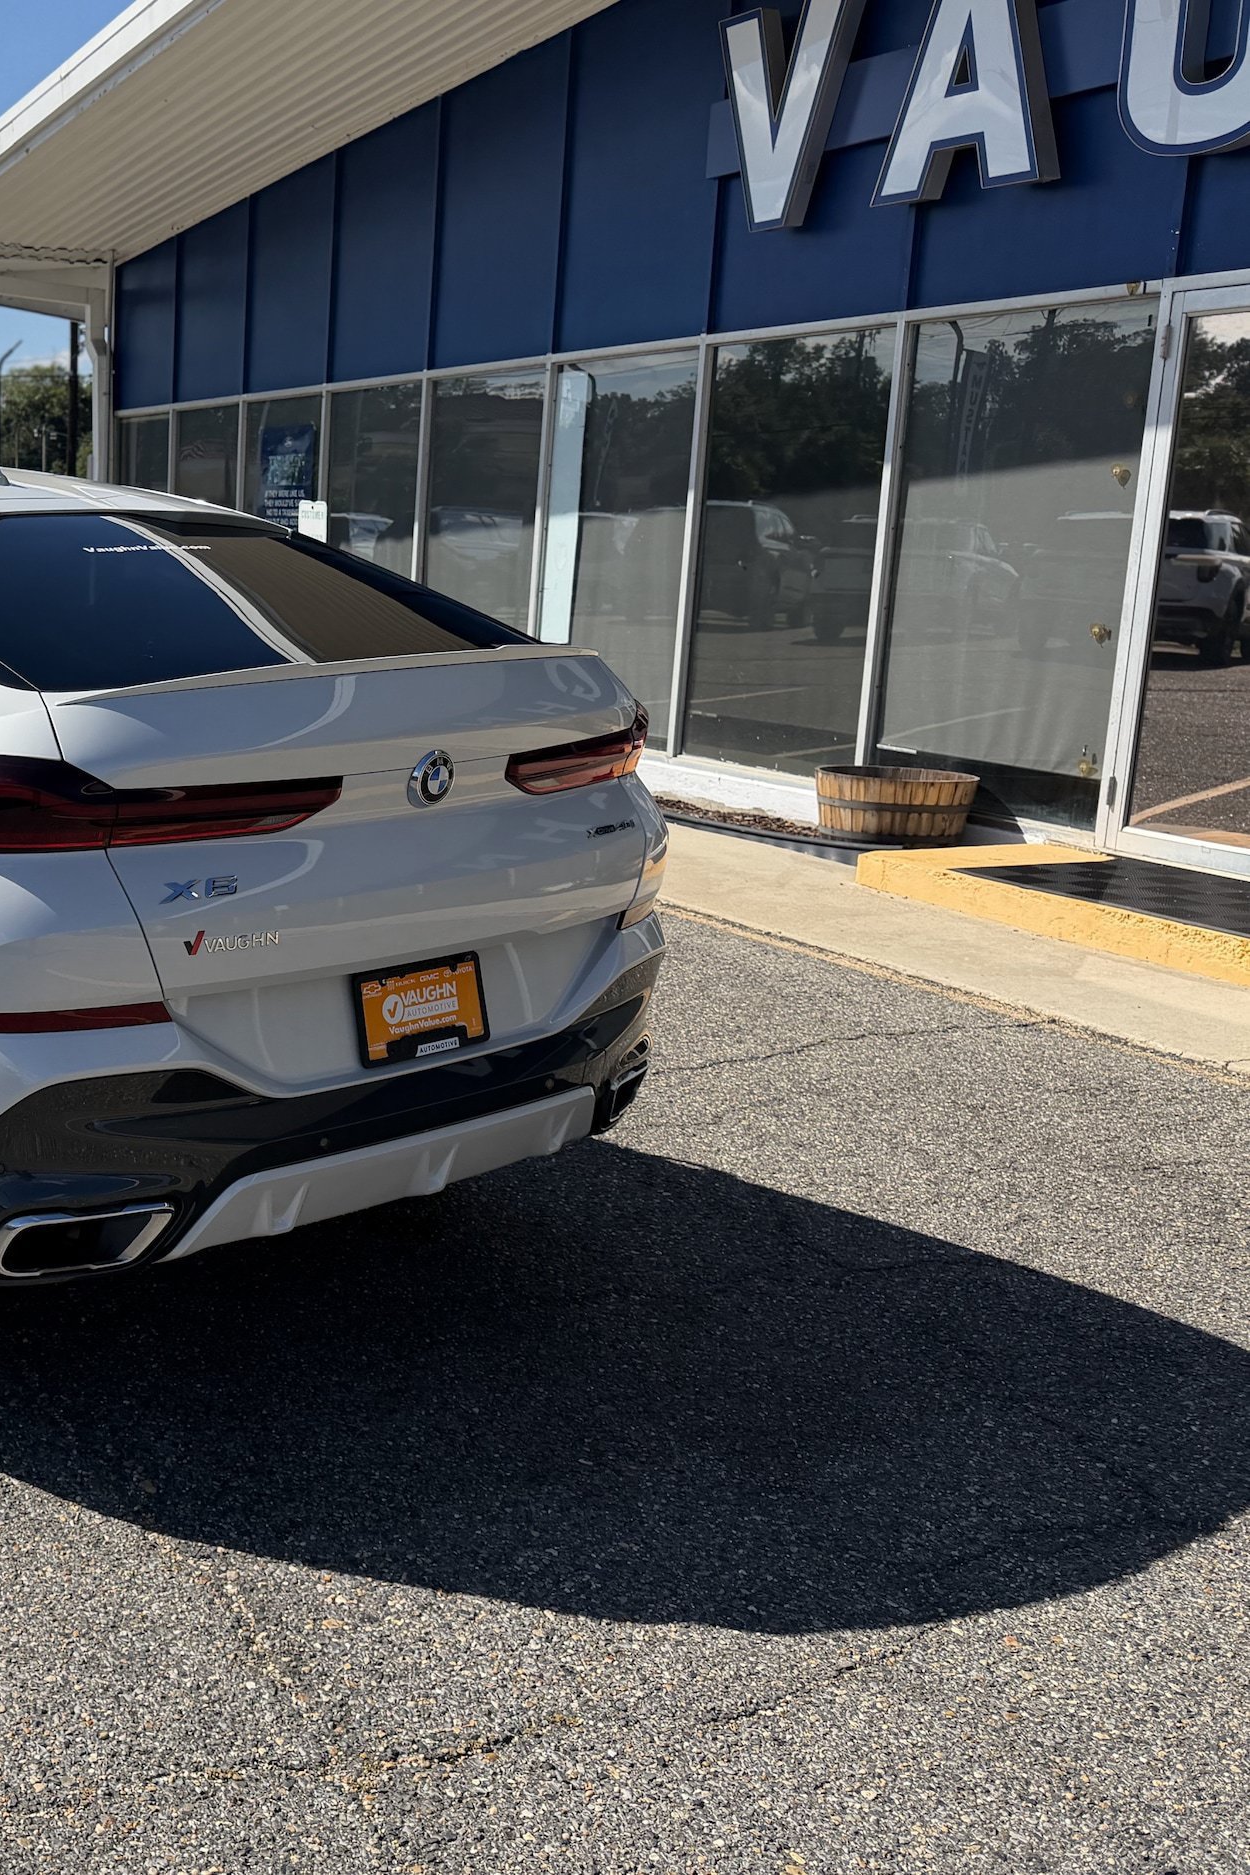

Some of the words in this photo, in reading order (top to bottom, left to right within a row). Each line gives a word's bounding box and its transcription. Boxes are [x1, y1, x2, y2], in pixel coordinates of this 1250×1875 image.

[158, 875, 238, 905] X6
[204, 930, 280, 954] VAUGHN
[419, 972, 440, 983] GMC
[452, 965, 473, 976] OYOTA
[400, 981, 457, 1006] VAUGHN
[406, 1000, 457, 1017] AUTOMOTIVE
[389, 1014, 457, 1034] VaughnValue.com
[418, 1040, 458, 1054] AUTOMOTIVE
